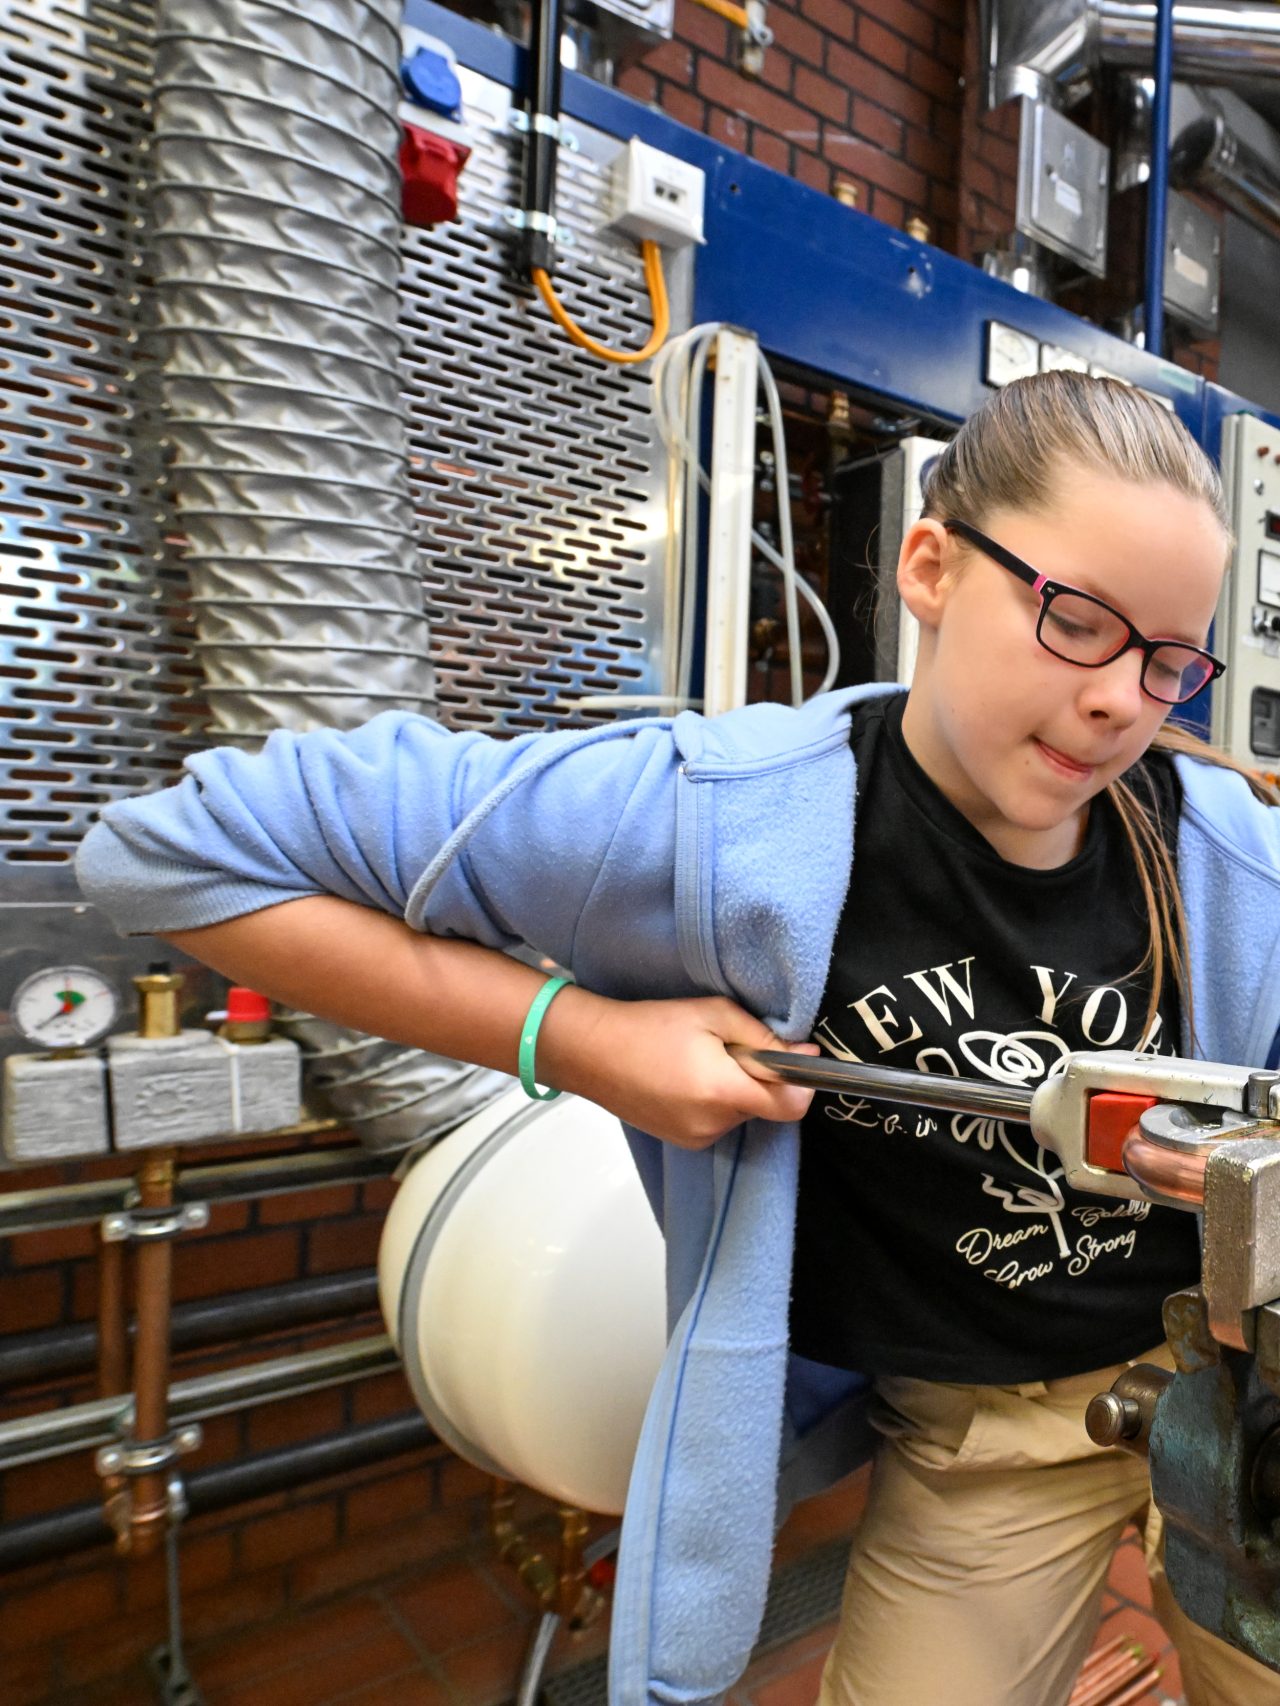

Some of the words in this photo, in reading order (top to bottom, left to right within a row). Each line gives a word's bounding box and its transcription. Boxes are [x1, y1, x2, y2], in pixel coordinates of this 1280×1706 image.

[812, 955, 976, 1064] NEW
[955, 1223, 1049, 1266] Dream
[983, 1260, 1054, 1290] Grow
[1067, 1229, 1137, 1276] Strong
